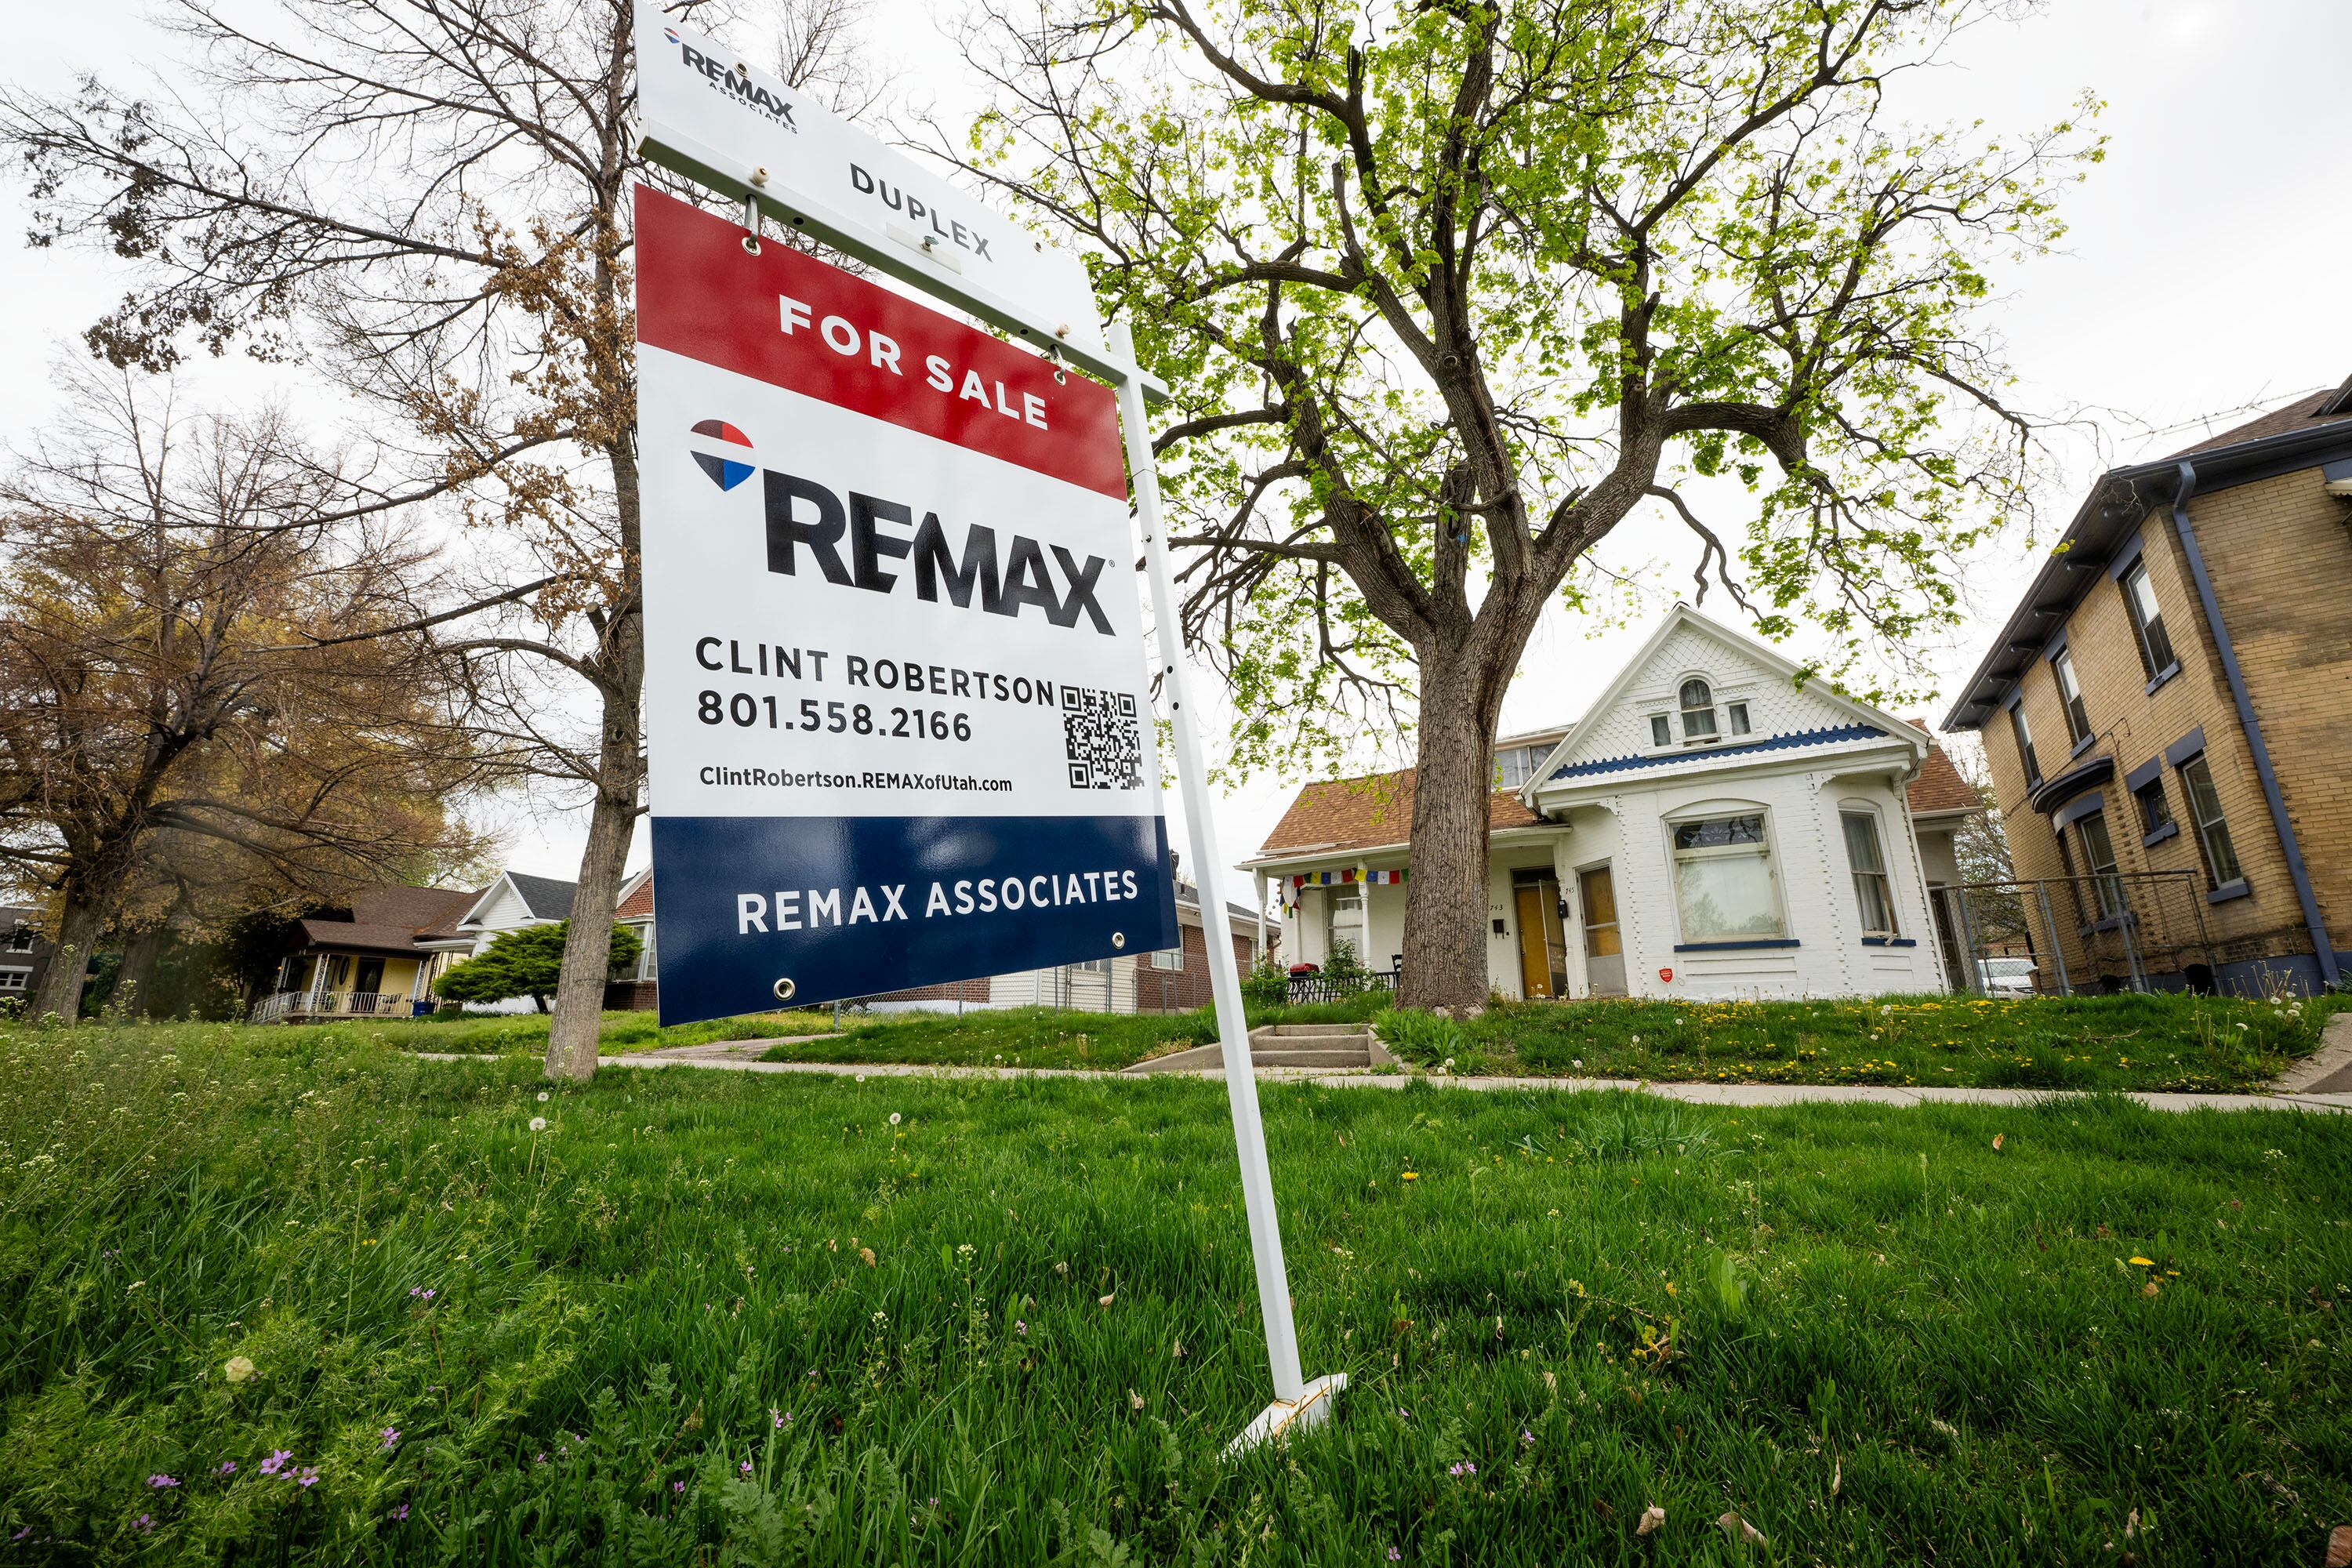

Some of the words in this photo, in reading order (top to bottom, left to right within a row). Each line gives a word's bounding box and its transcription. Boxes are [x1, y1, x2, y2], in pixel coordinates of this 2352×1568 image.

[682, 43, 797, 127] REMAX
[710, 82, 797, 135] ASSOCIATES
[851, 163, 993, 263] DUPLEX
[779, 295, 903, 376] FOR
[927, 355, 1048, 431] SALE
[764, 469, 1116, 637] REMAX
[696, 637, 829, 682] CLINT
[847, 655, 1054, 707] ROBERTSON
[699, 690, 971, 742] 801.558.2166
[699, 767, 1012, 792] ClintRobertson.REMAXofUtah.com
[738, 884, 909, 935] REMAX
[926, 870, 1138, 918] ASSOCIATES
